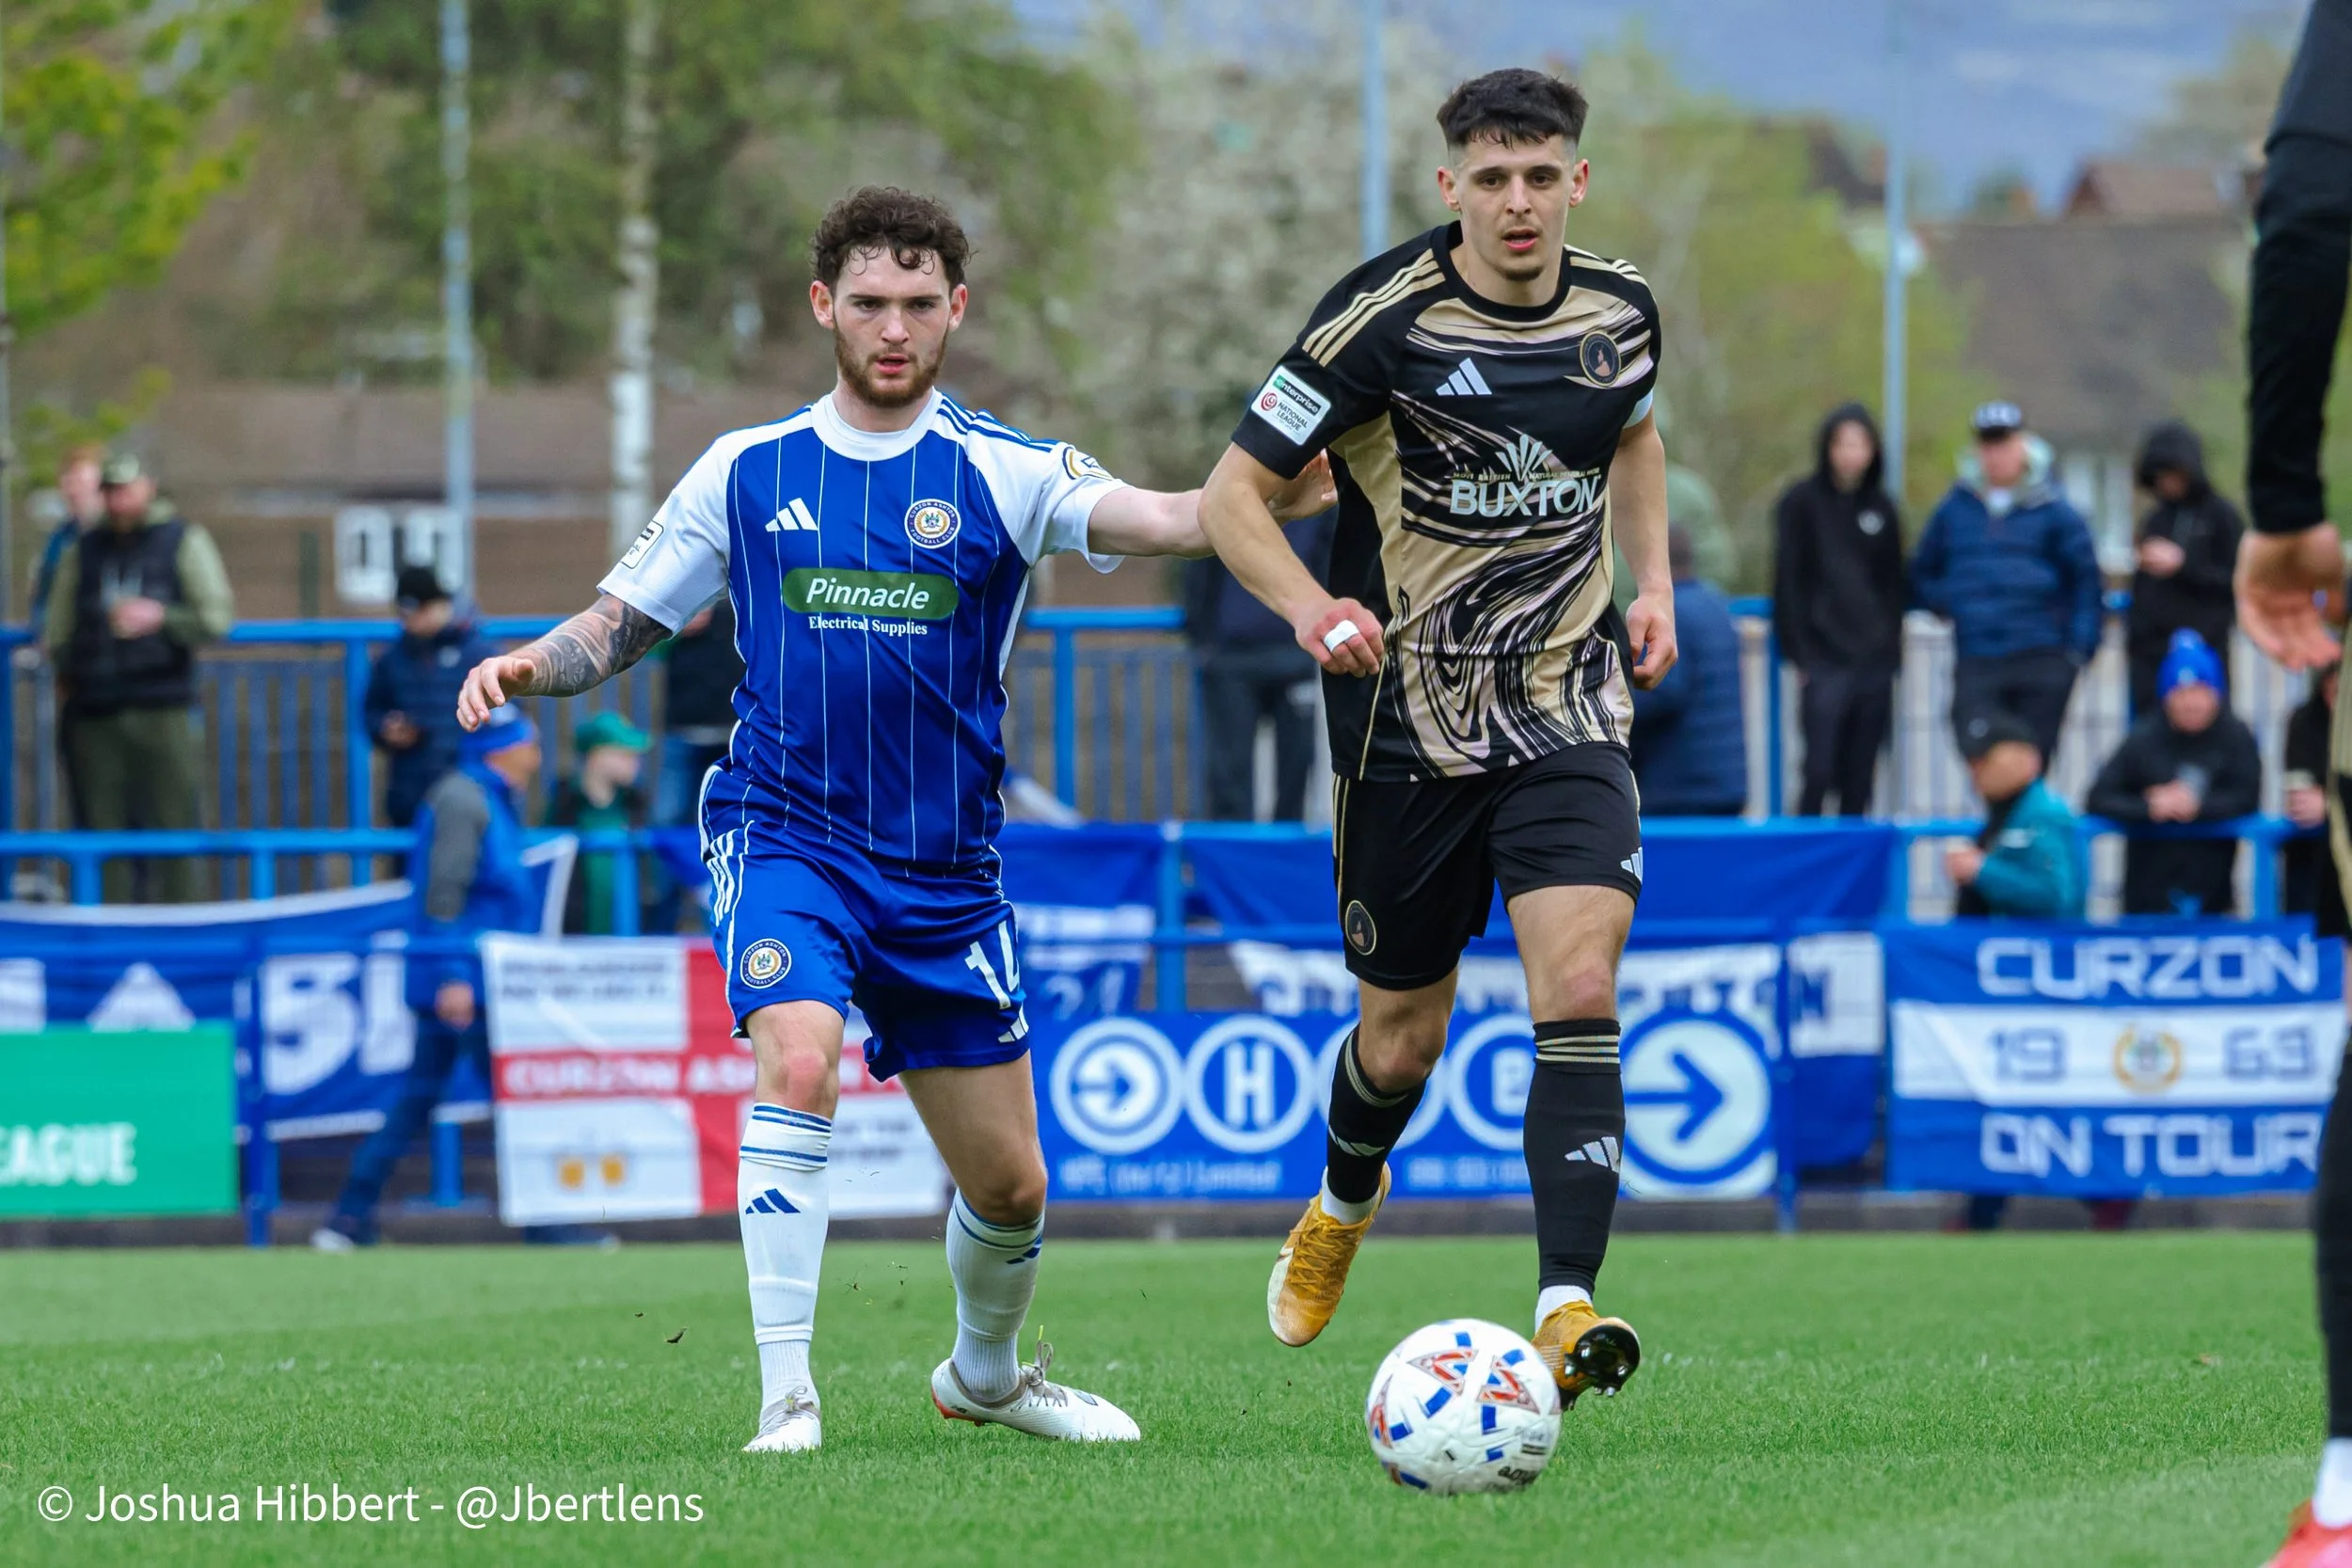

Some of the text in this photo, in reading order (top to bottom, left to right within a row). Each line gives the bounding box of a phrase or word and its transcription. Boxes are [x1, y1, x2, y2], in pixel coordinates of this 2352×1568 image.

[1276, 378, 1319, 413] enterprise
[1277, 411, 1301, 431] LEAGUE
[1278, 402, 1308, 428] NATIONAL
[909, 501, 955, 518] CURZON ASHTON
[1450, 475, 1601, 517] BUXTON
[911, 527, 955, 544] FOOTBALL CLUB
[806, 578, 930, 610] Pinnacle
[809, 616, 928, 637] Electrical Supplies
[743, 942, 787, 963] CURZON ASHTON
[1979, 934, 2318, 999] CURZON
[744, 967, 787, 985] FOOTBALL CLUB
[1993, 1026, 2314, 1083] 19 63
[1226, 1042, 1274, 1127] H
[1980, 1112, 2326, 1178] ON TOUR
